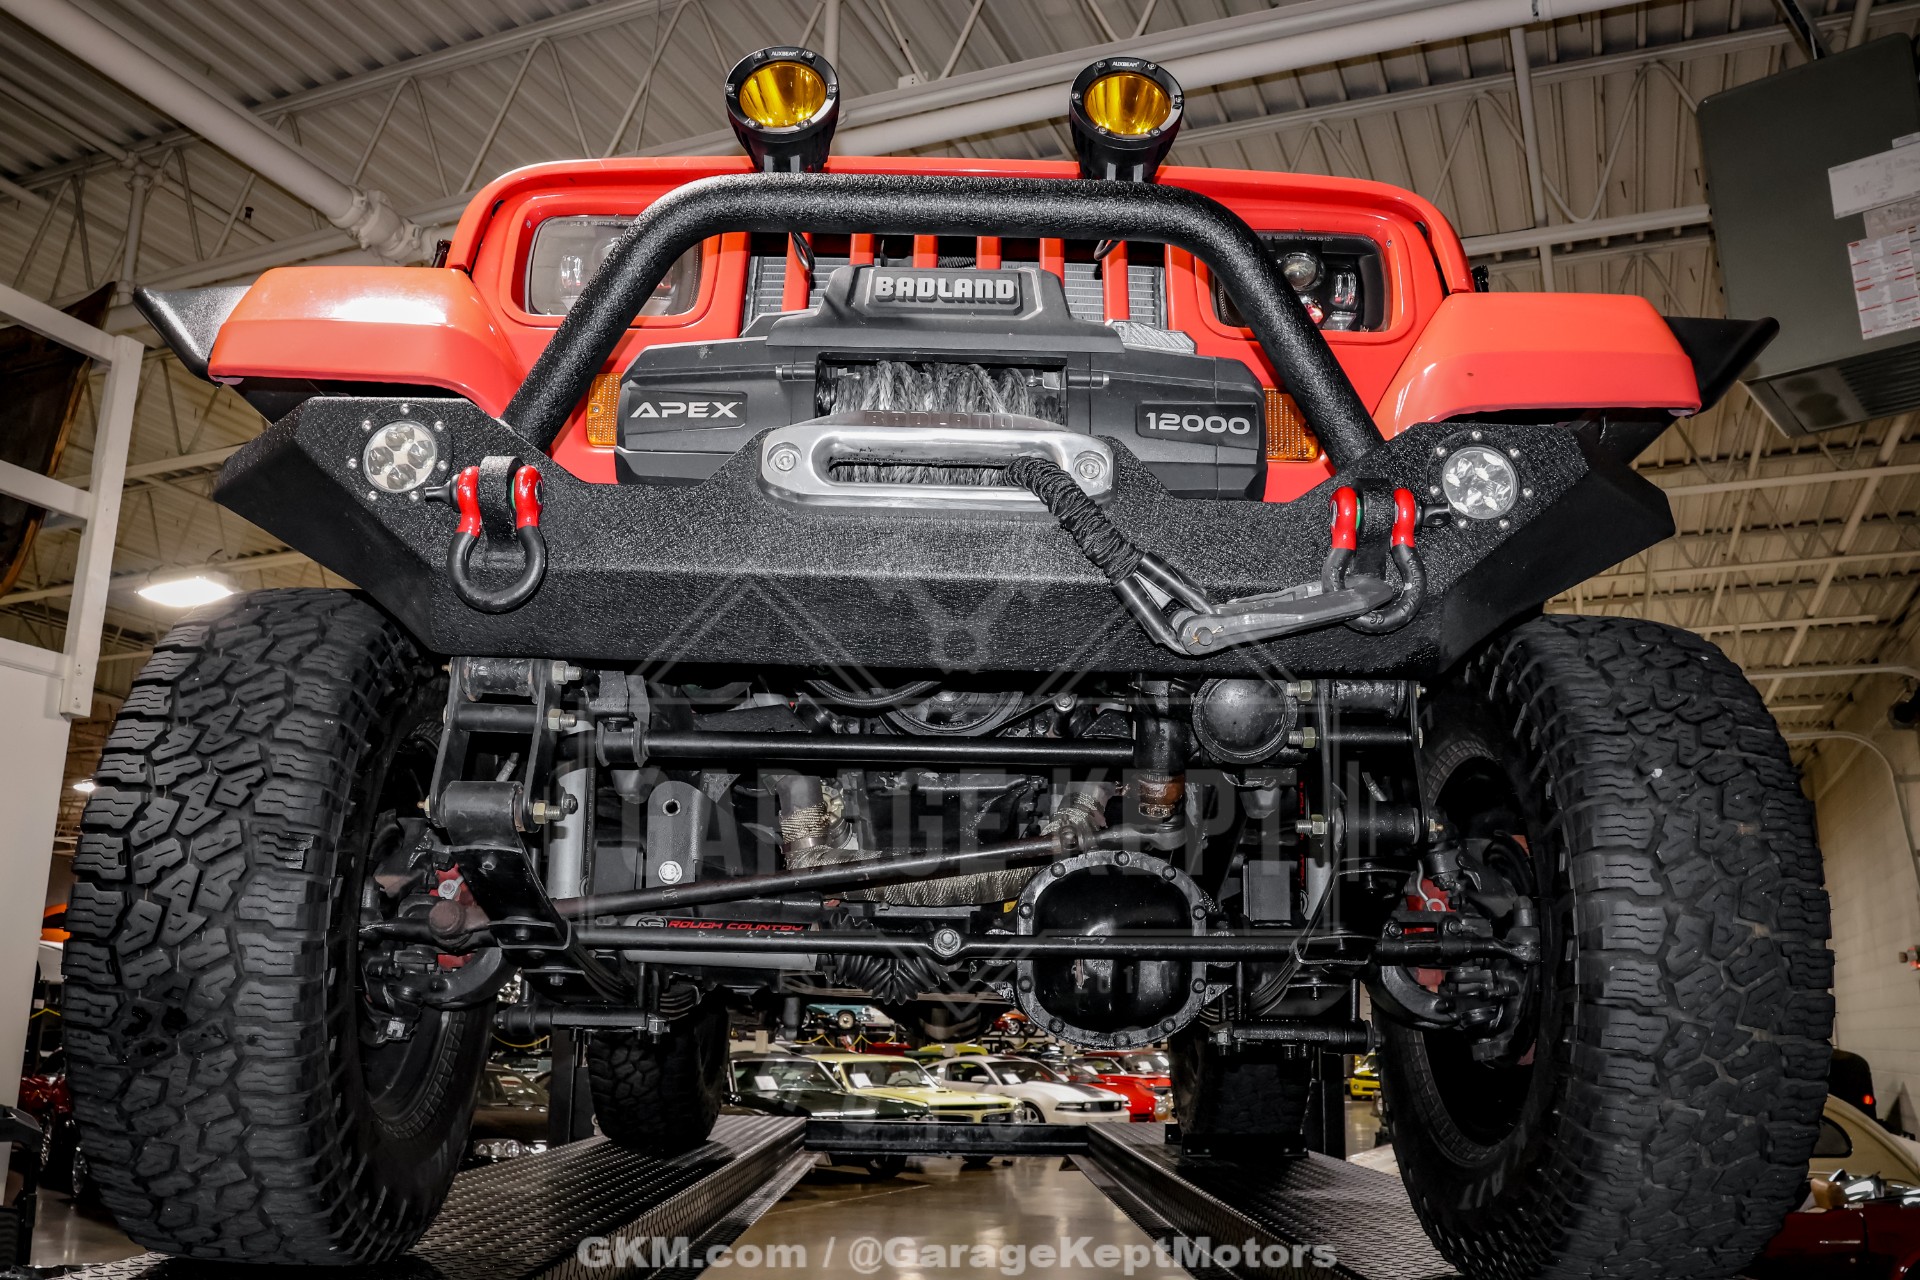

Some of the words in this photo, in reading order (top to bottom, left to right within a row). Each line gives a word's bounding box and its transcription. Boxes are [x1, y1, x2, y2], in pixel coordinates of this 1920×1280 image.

[875, 276, 1016, 302] BADLAND
[630, 401, 739, 418] APEX
[1145, 412, 1251, 435] 12000
[668, 919, 722, 929] ROUGH
